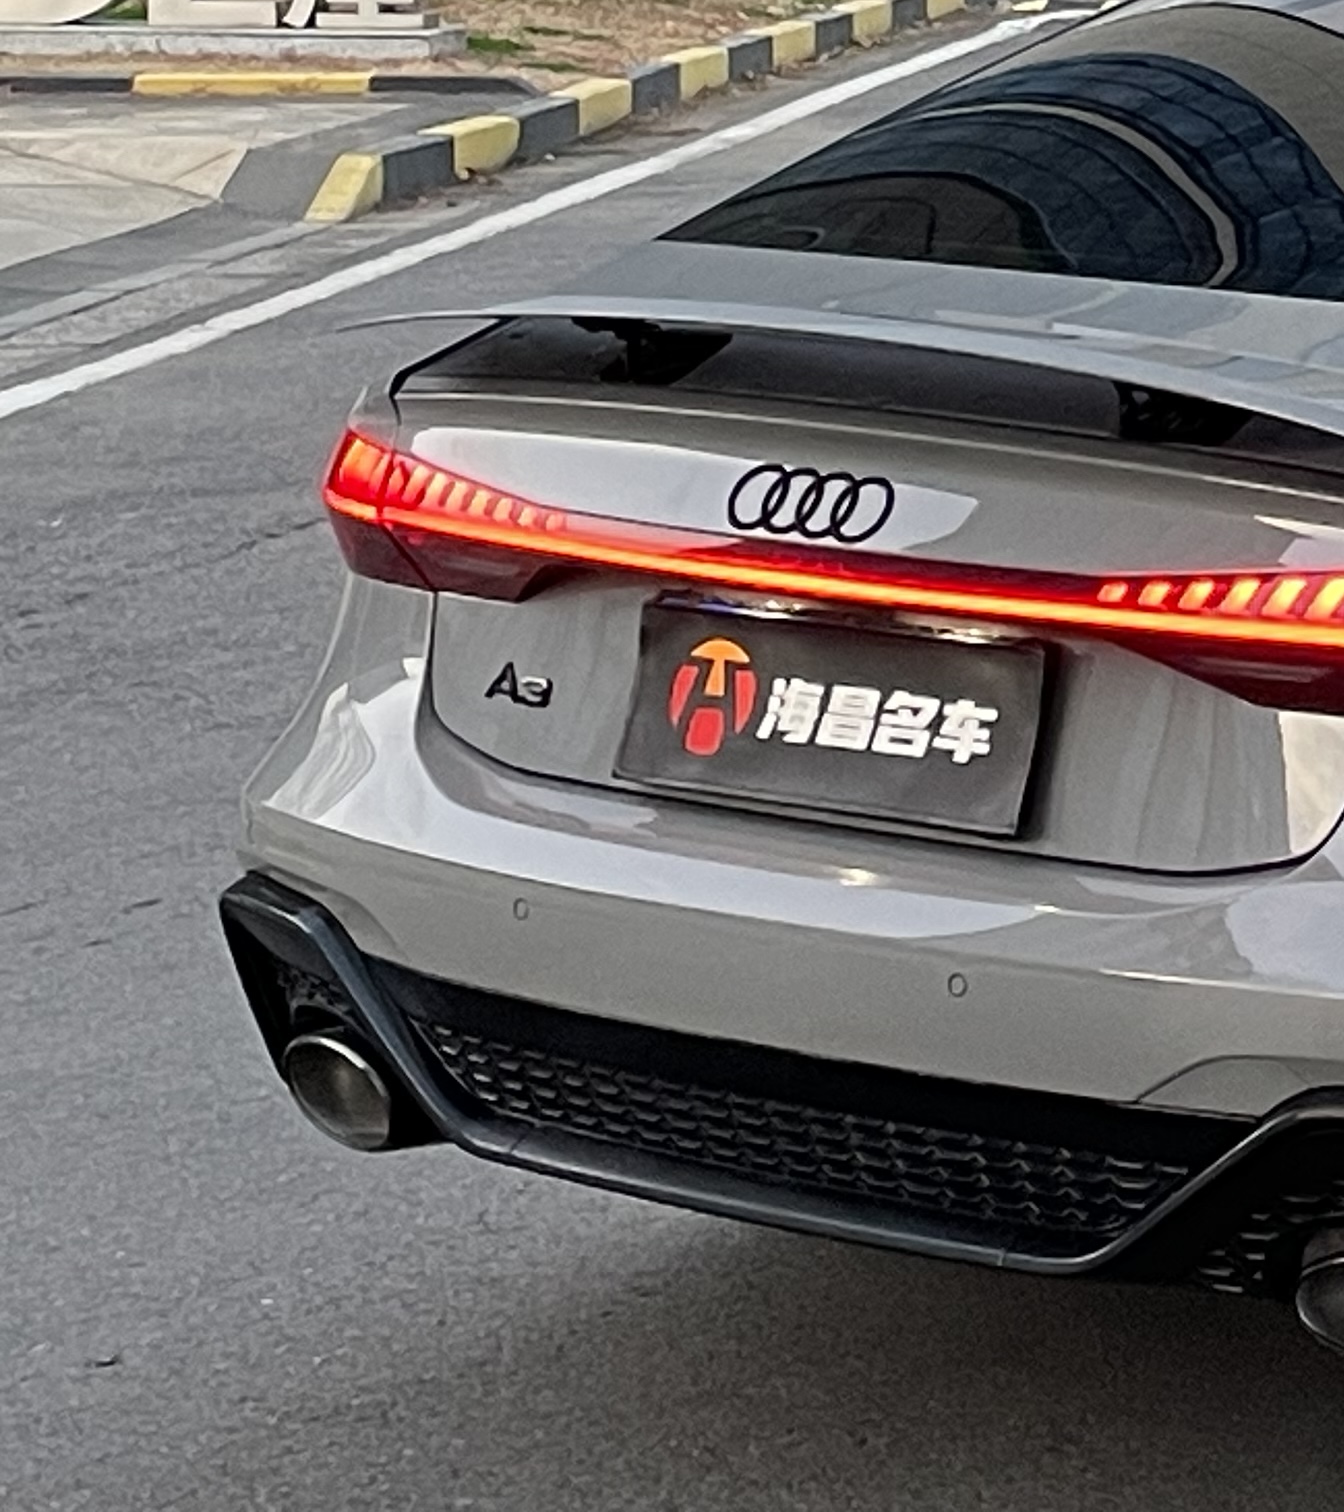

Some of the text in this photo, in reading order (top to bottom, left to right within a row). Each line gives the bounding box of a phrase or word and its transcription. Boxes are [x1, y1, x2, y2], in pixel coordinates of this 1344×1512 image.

[484, 661, 553, 708] A3
[756, 678, 998, 764] 海昌名车
